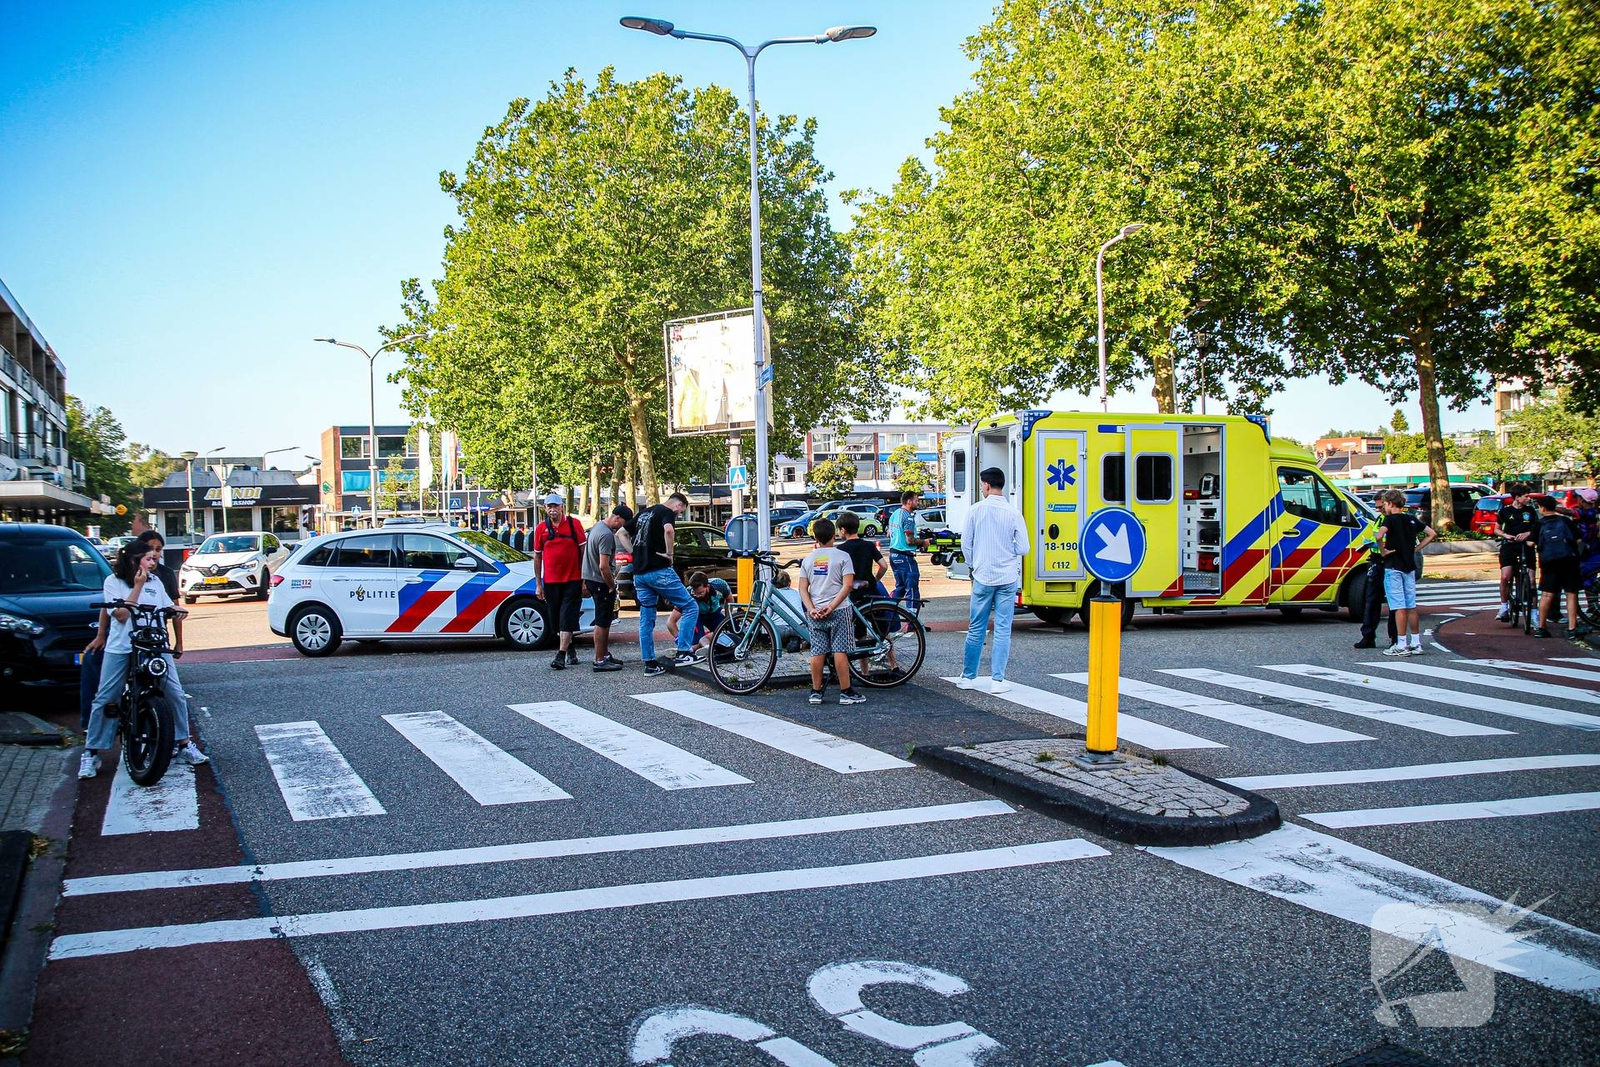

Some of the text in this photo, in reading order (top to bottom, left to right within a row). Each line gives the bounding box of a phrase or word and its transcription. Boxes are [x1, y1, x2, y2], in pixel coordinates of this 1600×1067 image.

[1045, 542, 1078, 551] 18-190
[1057, 561, 1070, 569] 112
[349, 589, 396, 601] POLITIE
